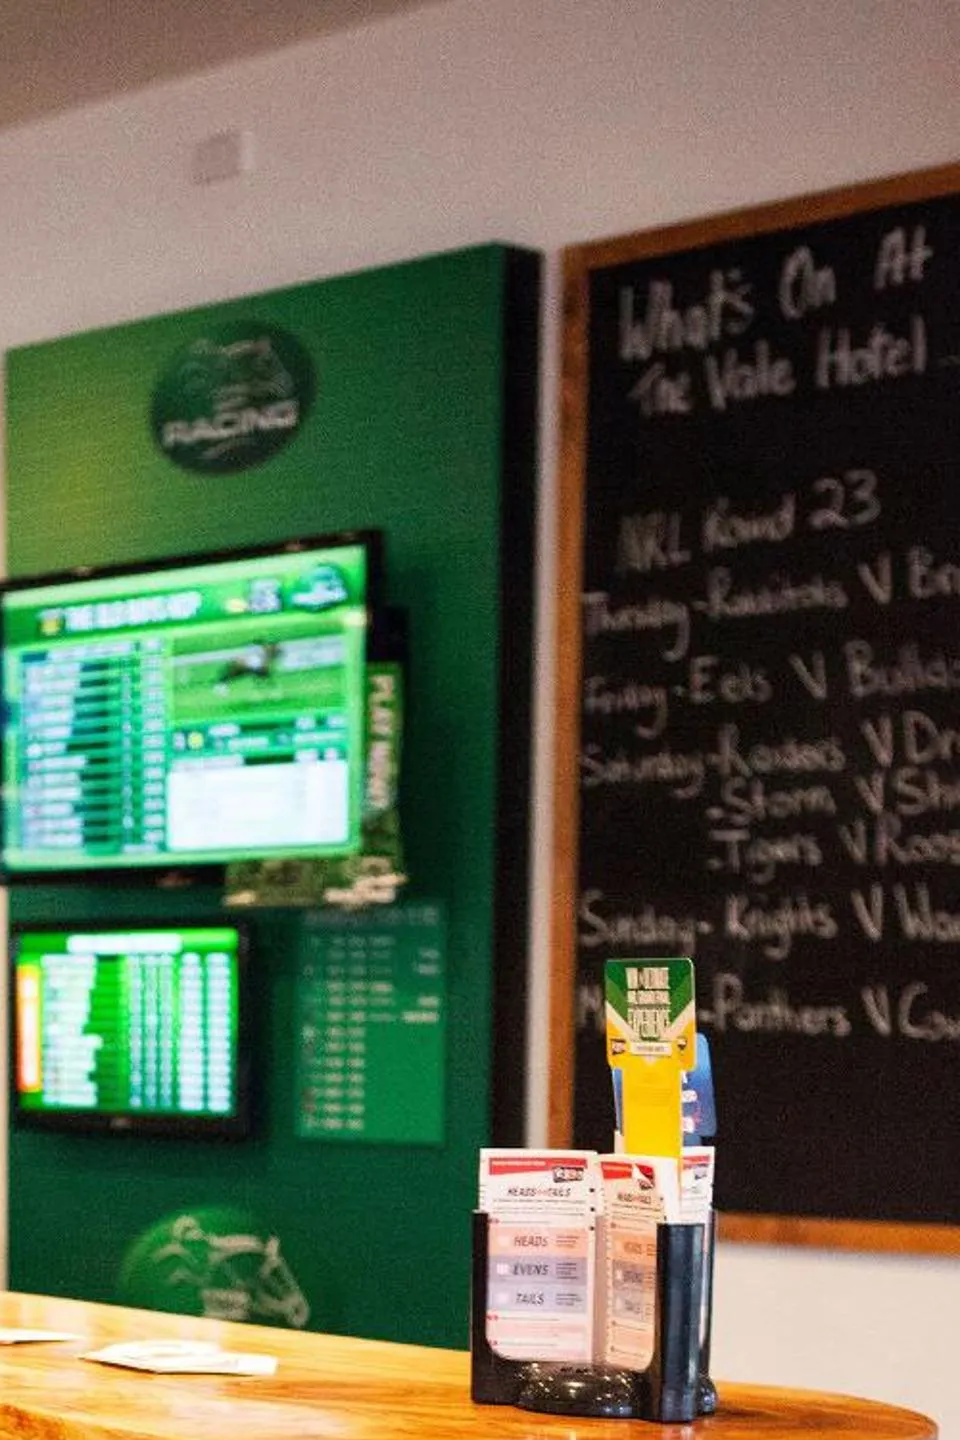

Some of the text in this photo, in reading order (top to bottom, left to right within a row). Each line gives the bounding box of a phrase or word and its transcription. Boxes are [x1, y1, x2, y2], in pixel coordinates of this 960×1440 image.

[780, 246, 836, 319] On
[874, 225, 934, 290] At
[704, 339, 796, 410] Vale
[818, 315, 927, 388] Hotel
[162, 398, 300, 448] RACING
[808, 469, 882, 529] 23
[857, 552, 892, 605] V
[790, 651, 827, 700] V
[860, 716, 893, 767] V
[853, 770, 885, 814] V
[839, 819, 868, 866] V
[850, 880, 884, 943] V
[860, 984, 892, 1037] V
[514, 1235, 549, 1248] HEADS
[513, 1263, 550, 1276] EVENS
[516, 1293, 545, 1306] TAILS
